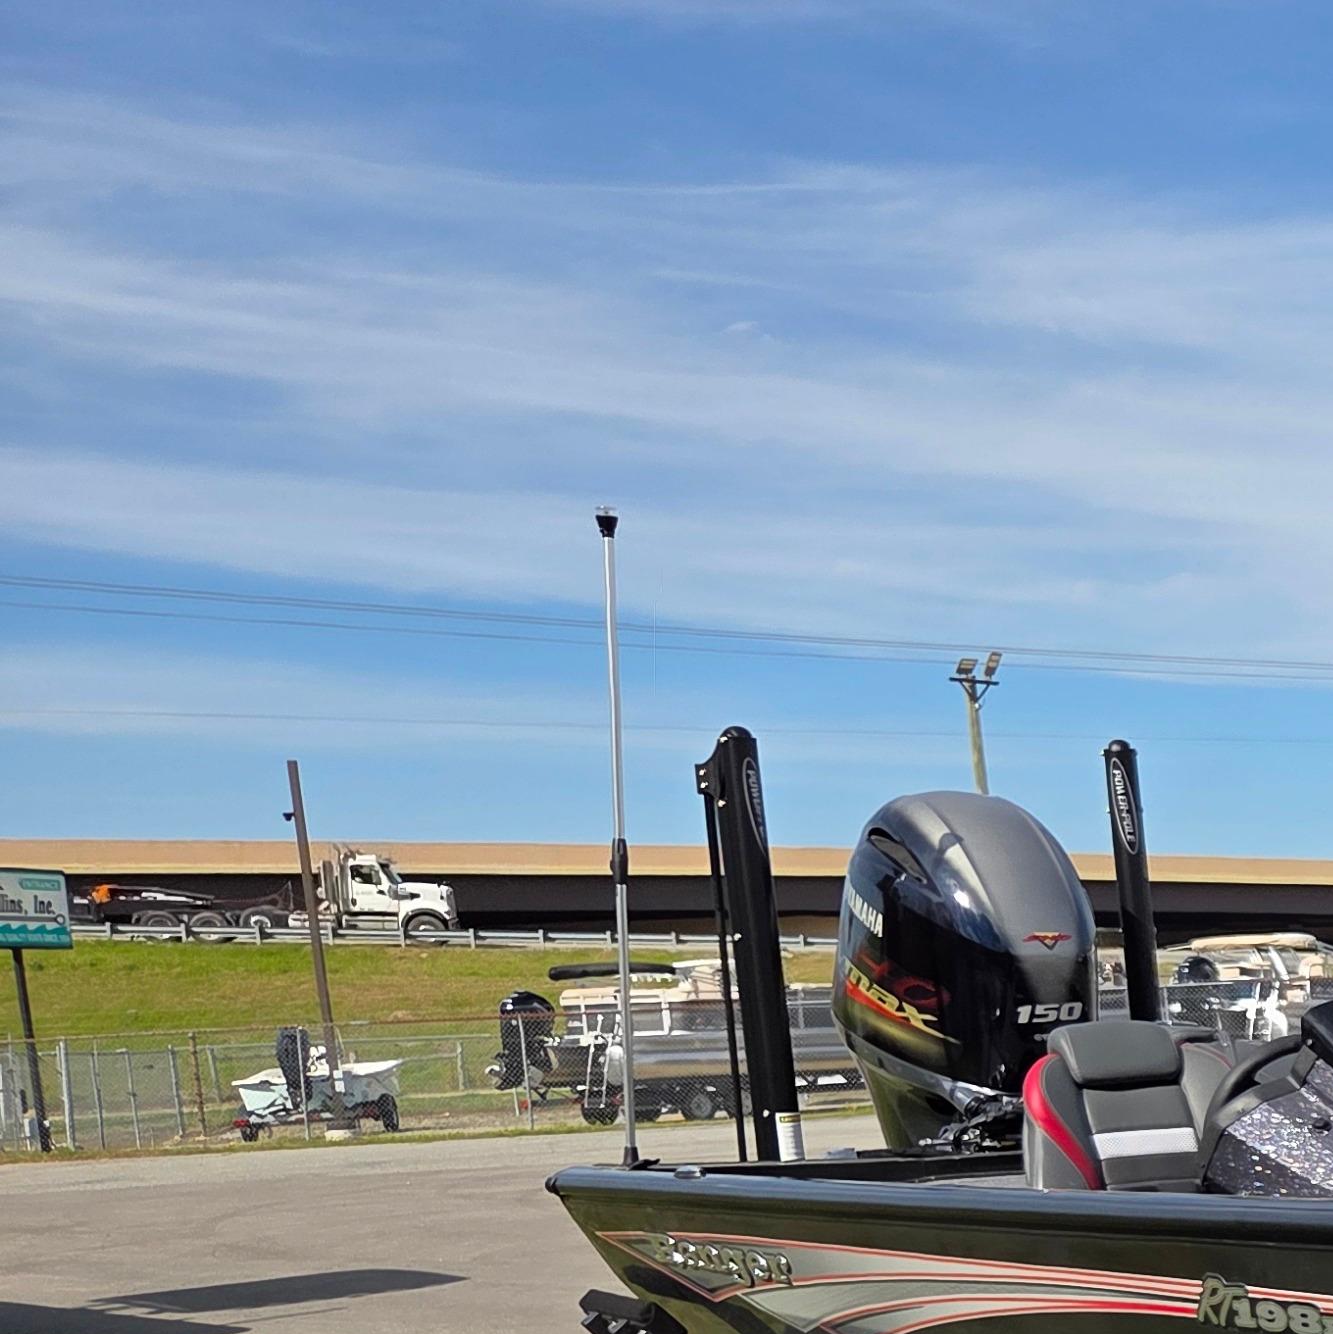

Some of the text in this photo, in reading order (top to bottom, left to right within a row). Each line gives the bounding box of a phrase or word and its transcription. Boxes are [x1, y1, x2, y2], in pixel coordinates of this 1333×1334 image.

[1113, 769, 1136, 842] POWER-POLE
[33, 894, 56, 915] Inc.
[848, 884, 883, 937] AMAHA
[1017, 1001, 1083, 1024] 150
[650, 1233, 793, 1287] Ranger
